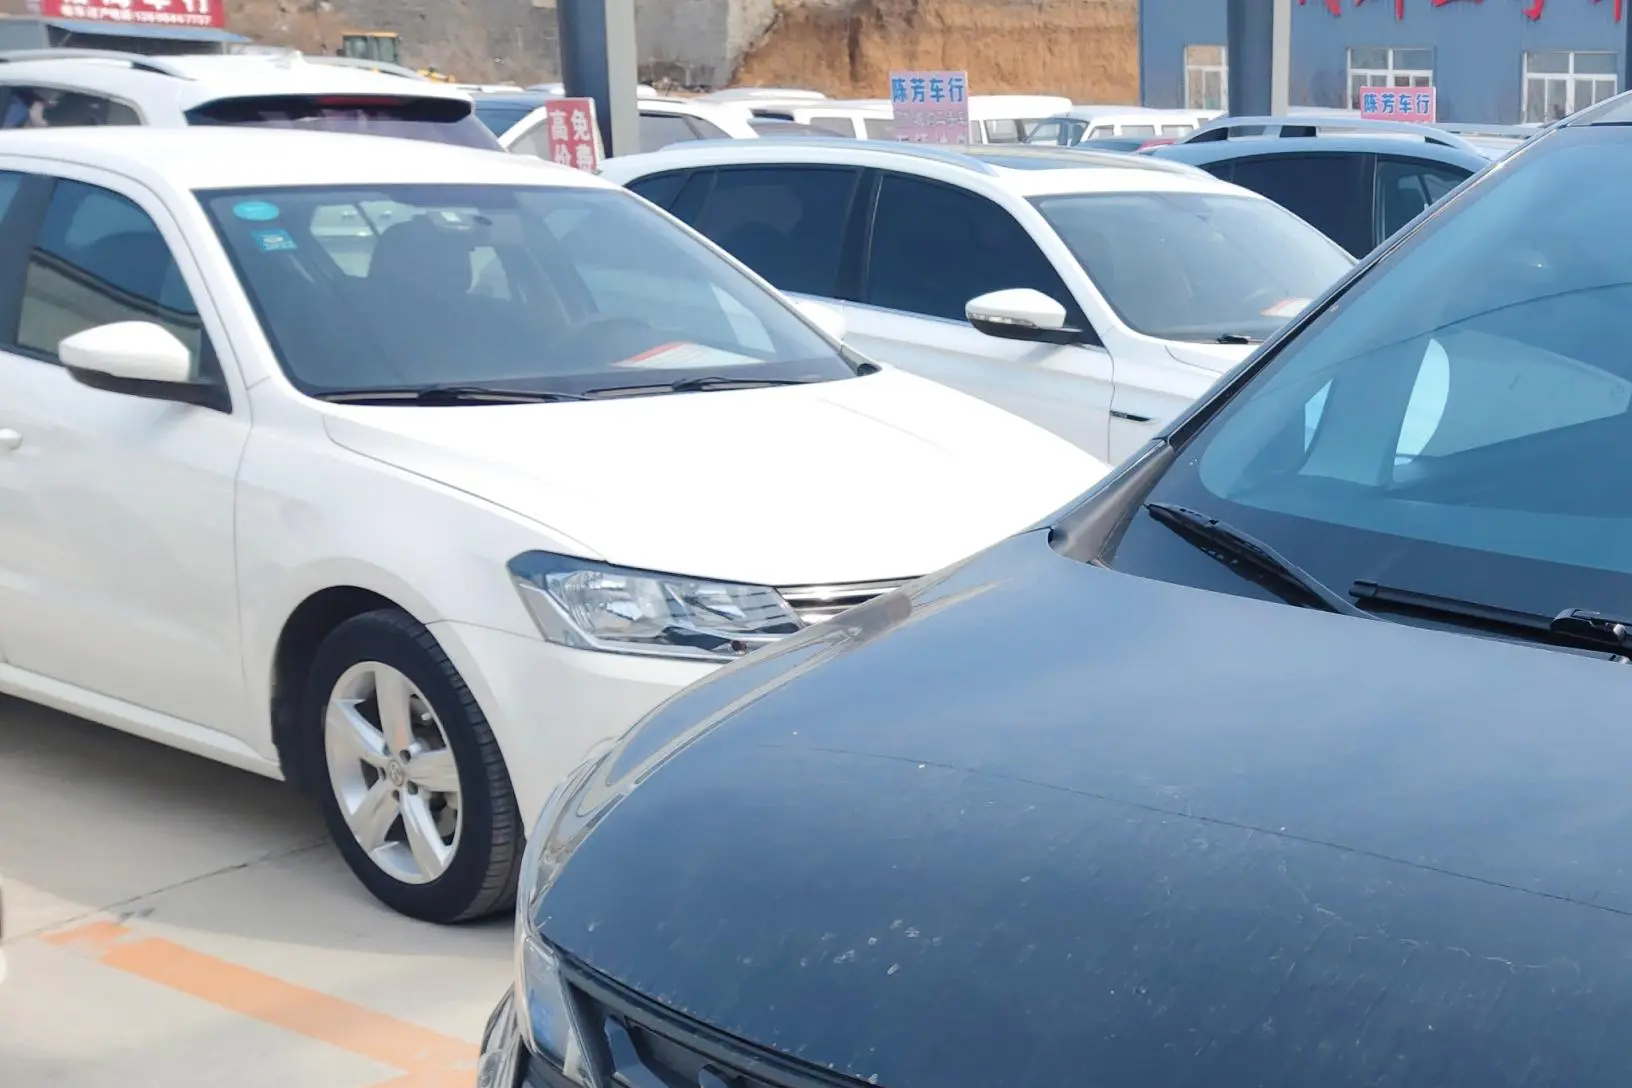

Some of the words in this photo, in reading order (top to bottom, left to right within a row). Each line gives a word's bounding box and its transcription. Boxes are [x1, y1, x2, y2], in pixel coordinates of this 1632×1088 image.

[891, 78, 964, 102] 陈芳车行
[1363, 93, 1430, 113] 陈芳车行
